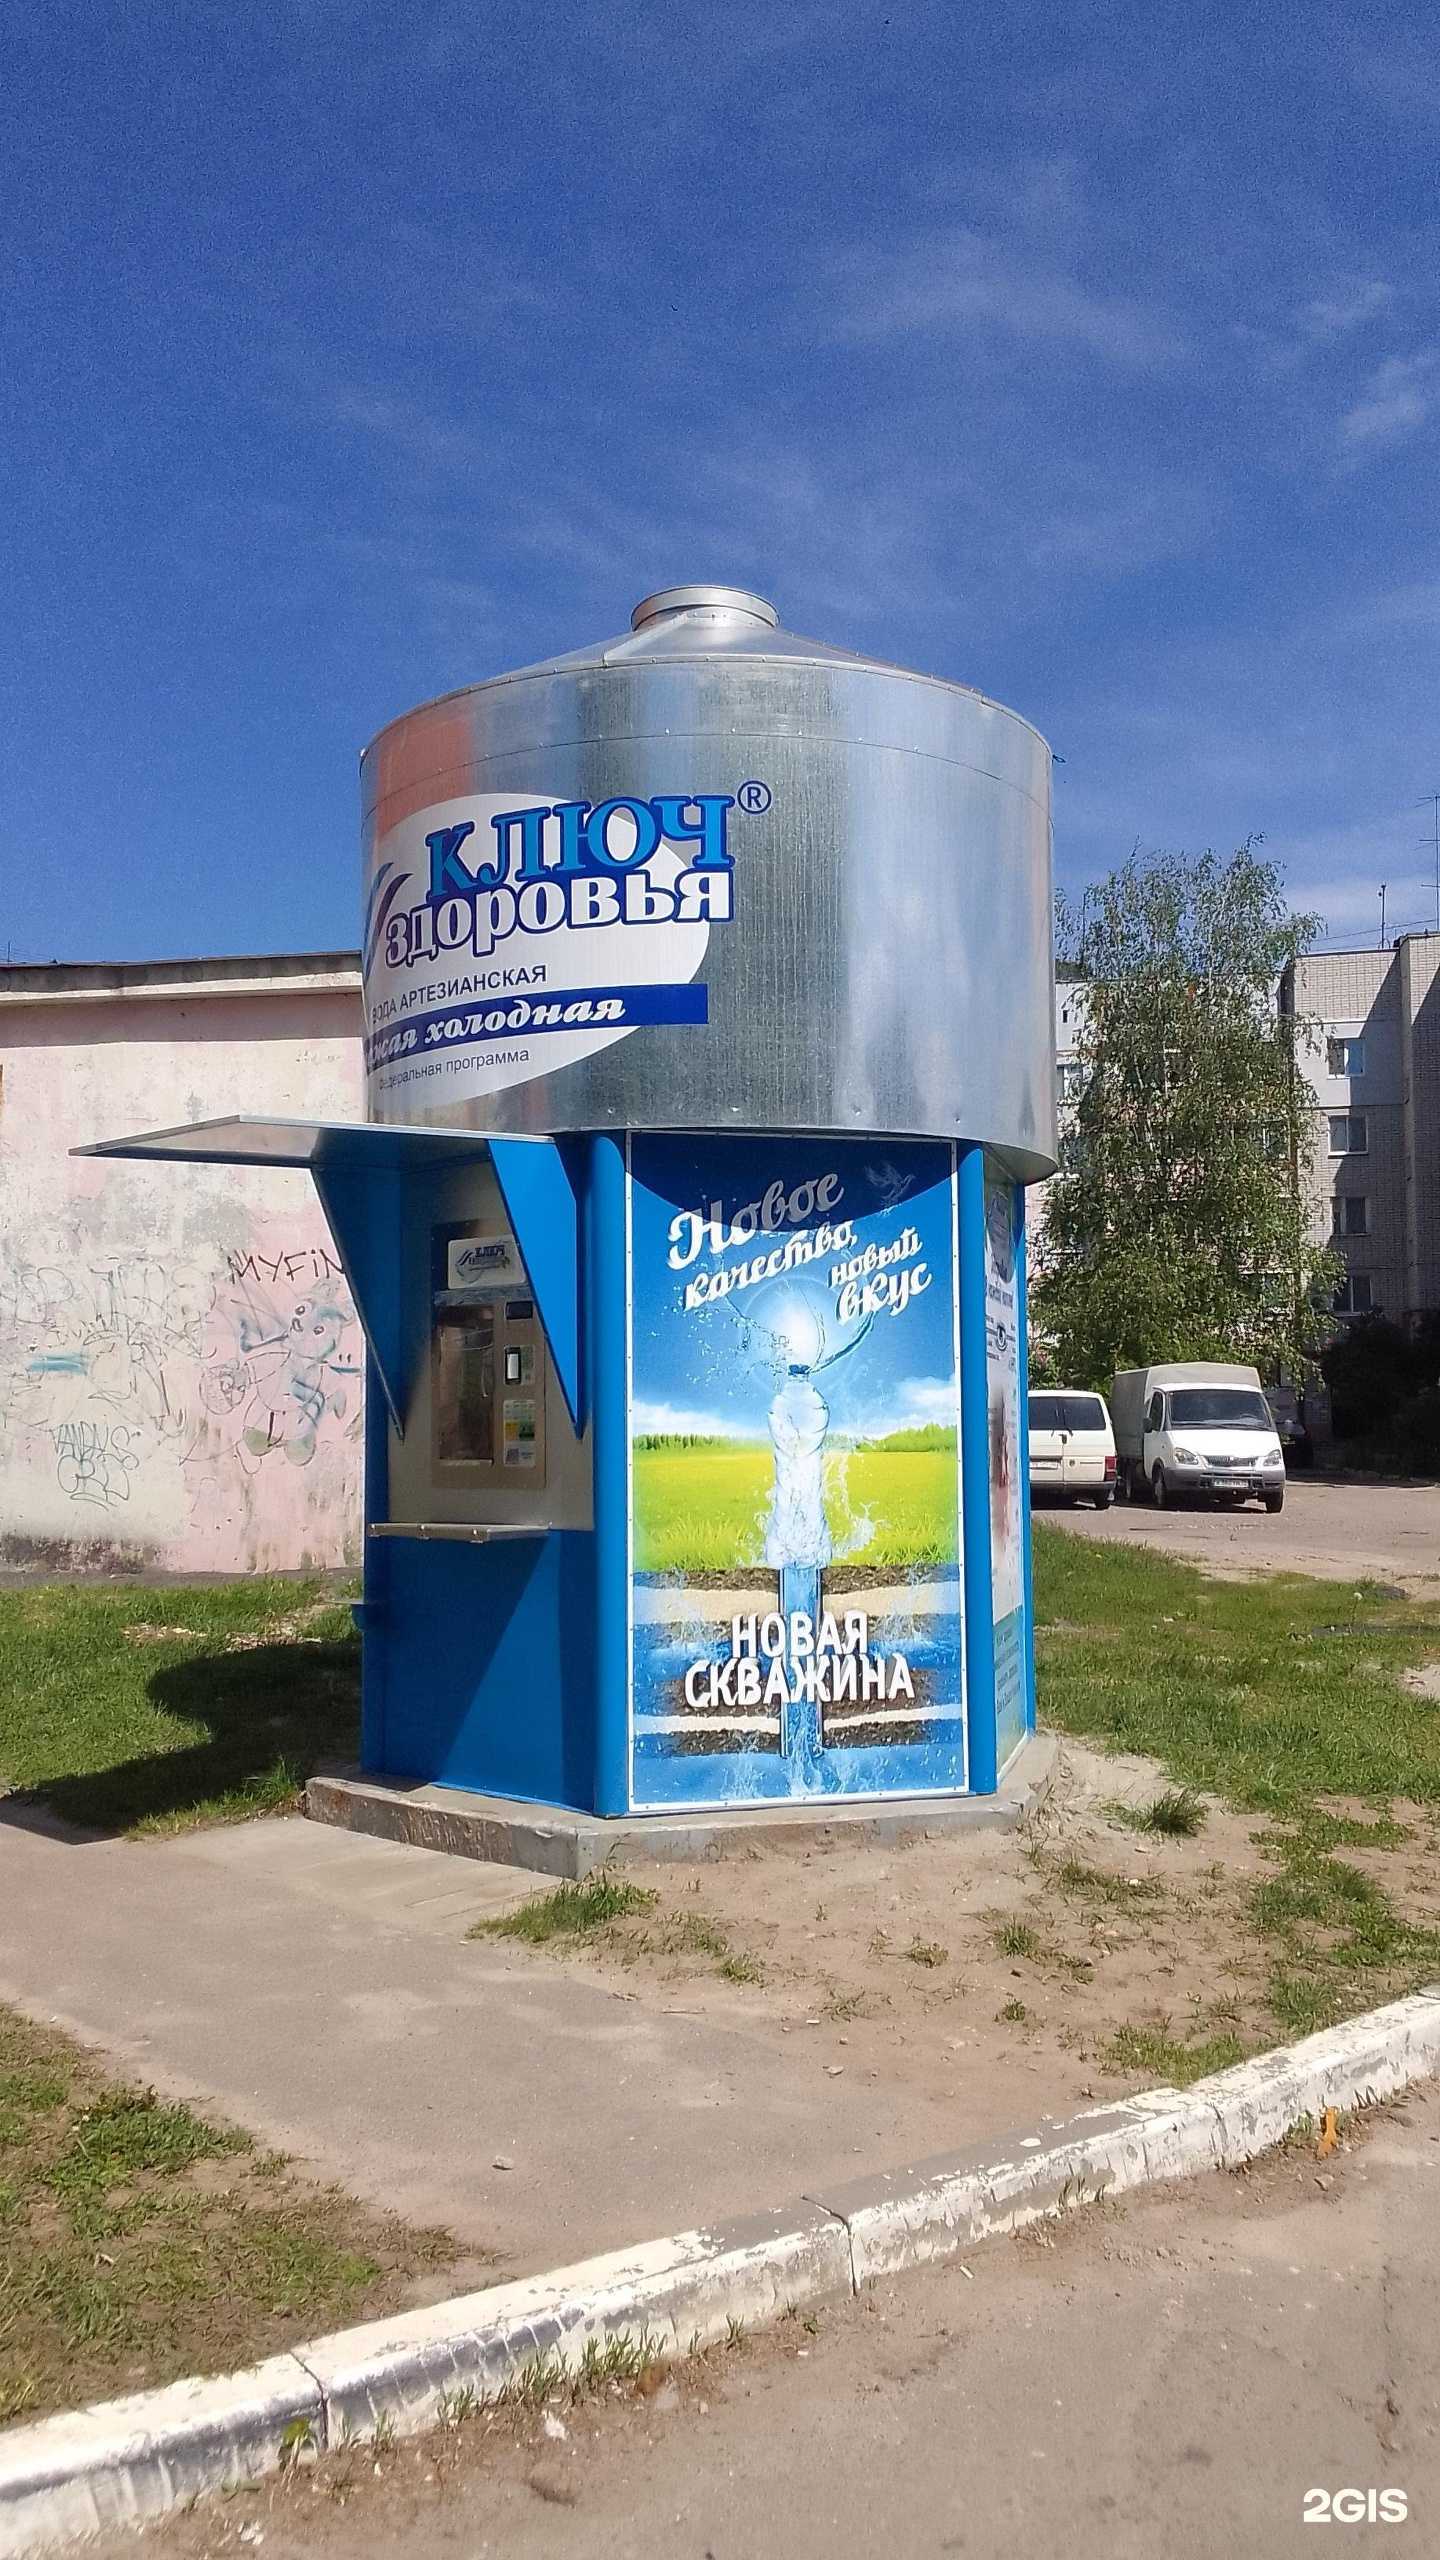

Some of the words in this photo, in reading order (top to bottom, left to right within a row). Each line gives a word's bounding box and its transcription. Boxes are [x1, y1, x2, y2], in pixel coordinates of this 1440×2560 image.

[400, 965, 547, 1010] АРТЕЗИАНСКАЯ
[425, 998, 625, 1044] холодная
[446, 1050, 529, 1072] программа
[667, 1172, 845, 1270] Новое
[684, 1219, 857, 1312] качество,
[828, 1226, 923, 1288] новый
[837, 1262, 932, 1325] вкус
[731, 1610, 869, 1659] НОВАЯ
[684, 1652, 916, 1709] СКВАЖИНА
